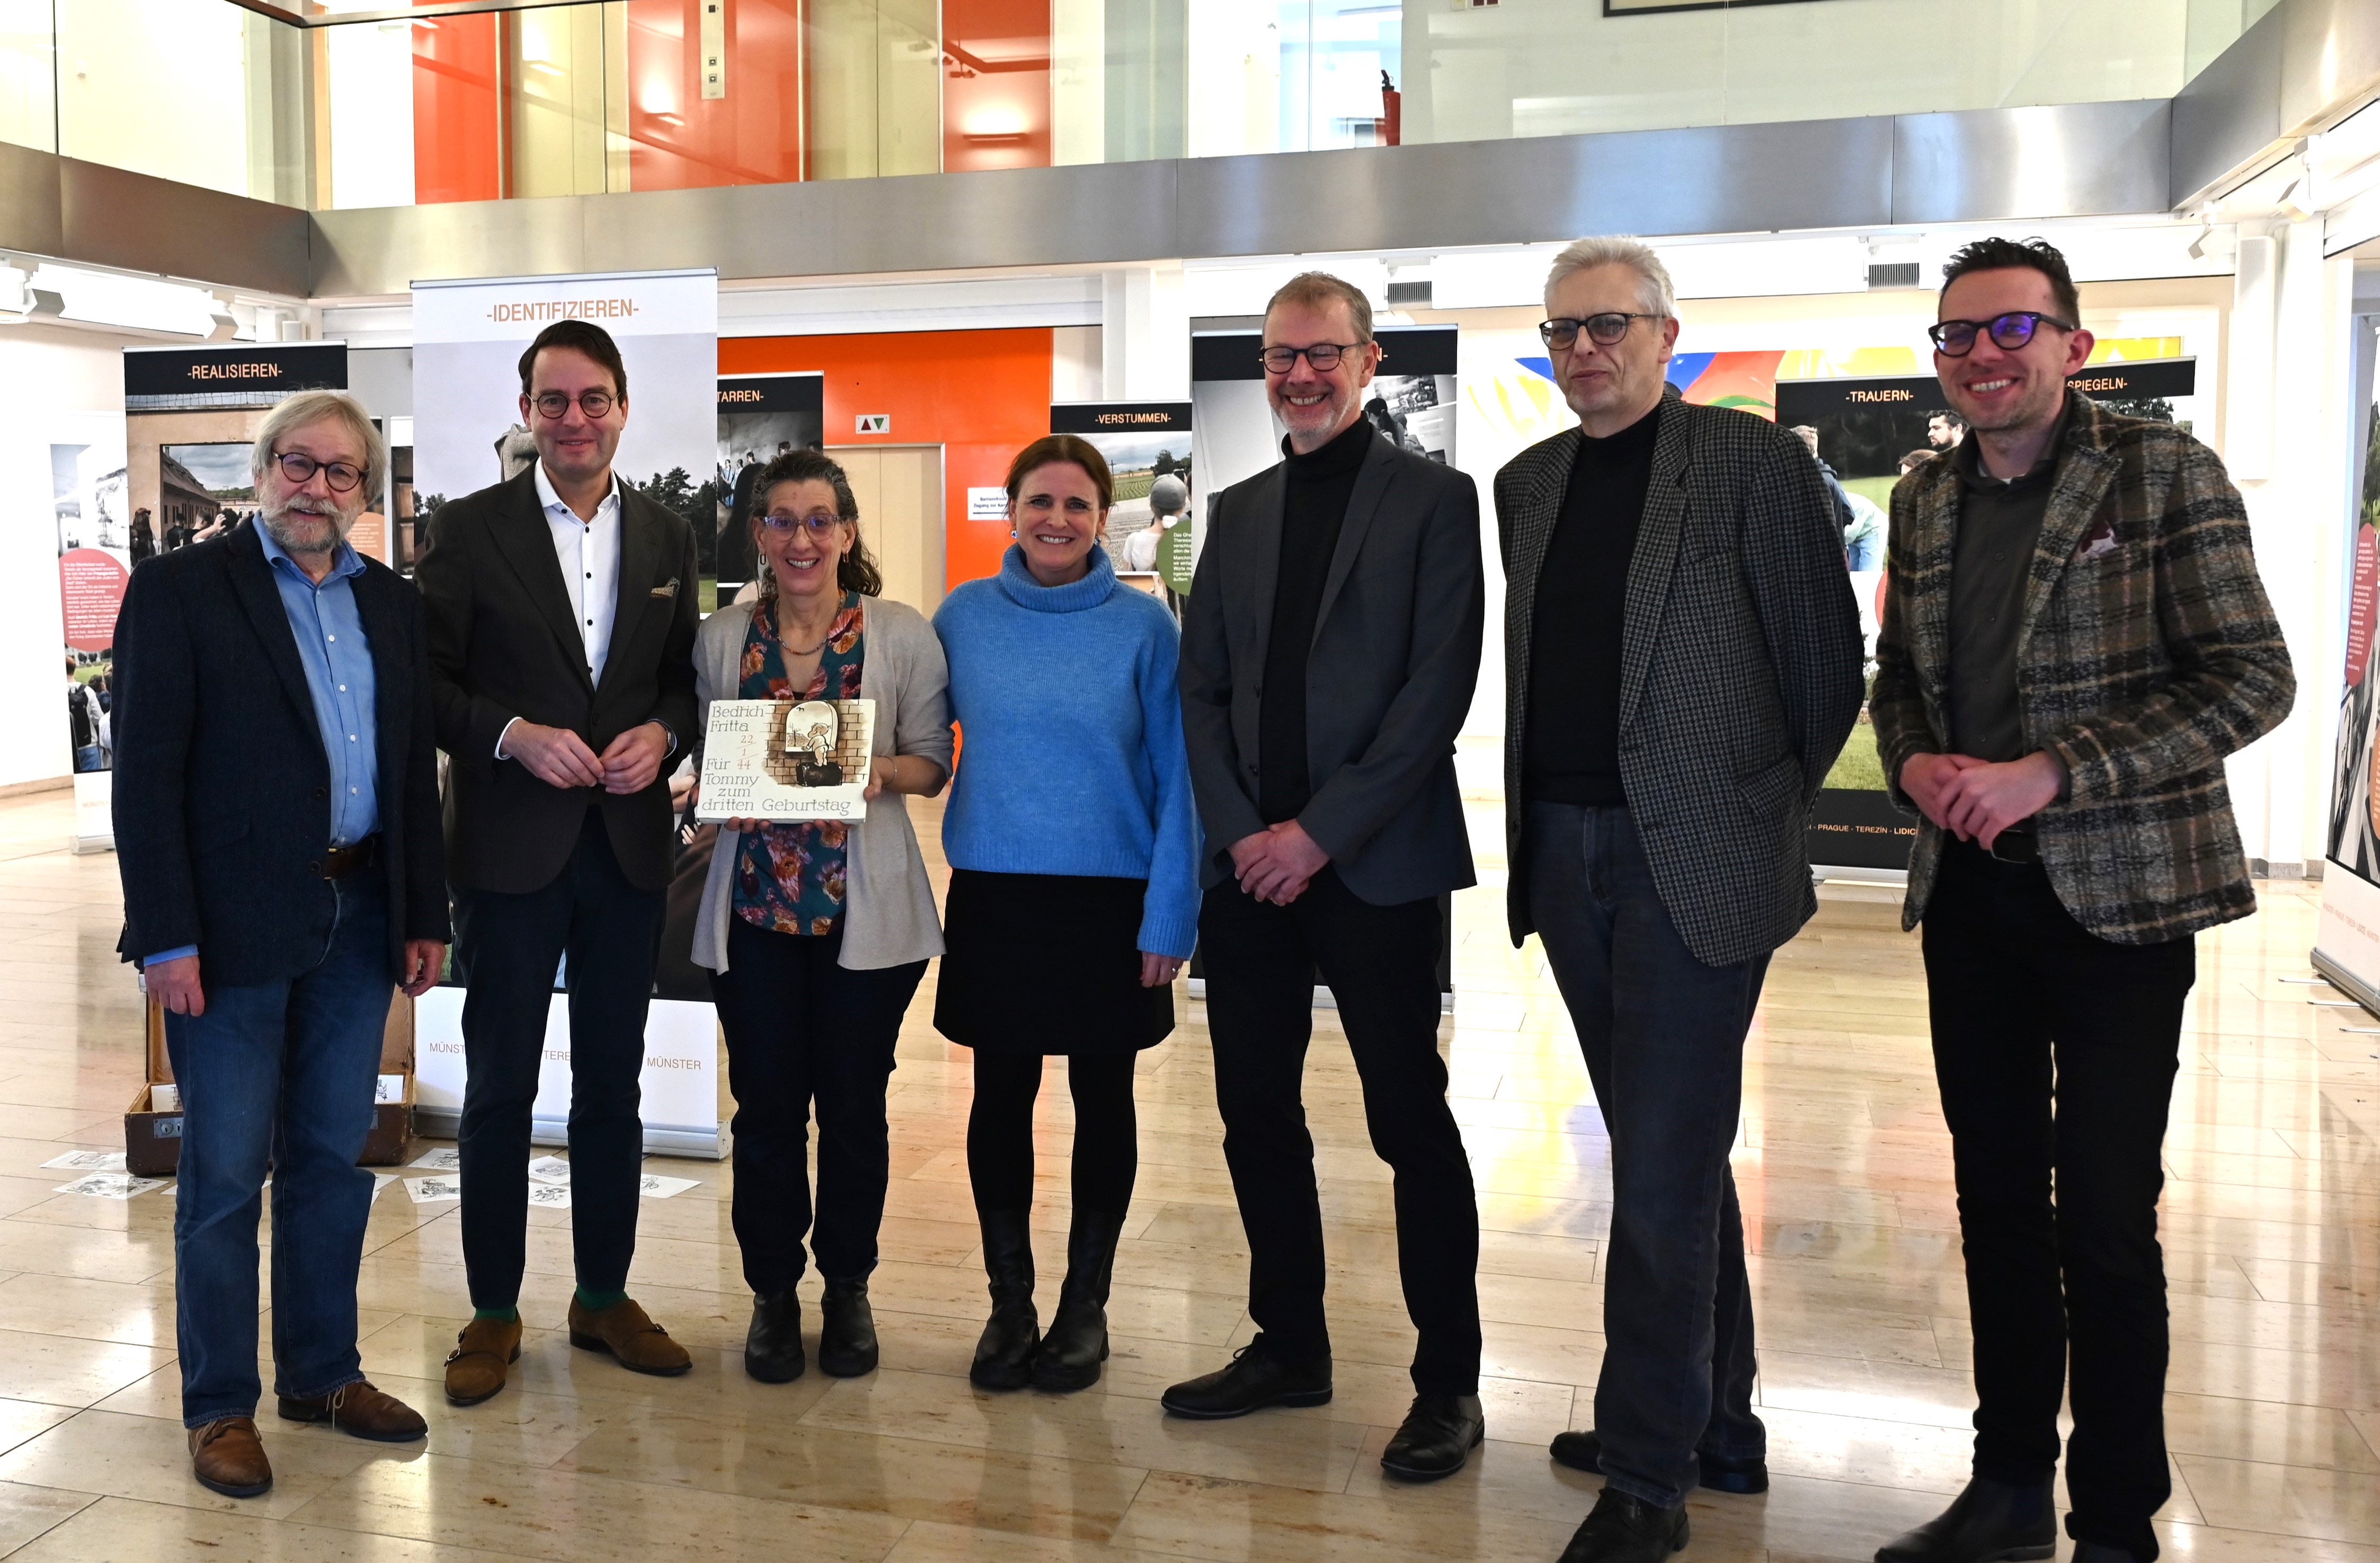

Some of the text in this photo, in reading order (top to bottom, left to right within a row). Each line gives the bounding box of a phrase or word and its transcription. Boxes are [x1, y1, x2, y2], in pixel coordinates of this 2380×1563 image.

[487, 298, 639, 322] -IDENTIFIZIEREN-
[188, 363, 282, 379] -REALISIEREN-
[1845, 389, 1914, 402] -TRAUERN-
[1095, 413, 1171, 424] -VERSTUMMEN-
[710, 720, 749, 732] Fritta
[705, 758, 731, 770] Für
[705, 774, 759, 787] Tommy
[717, 788, 751, 797] zum
[702, 798, 851, 816] dritten Geburtstag
[647, 1056, 701, 1070] MÜNSTER
